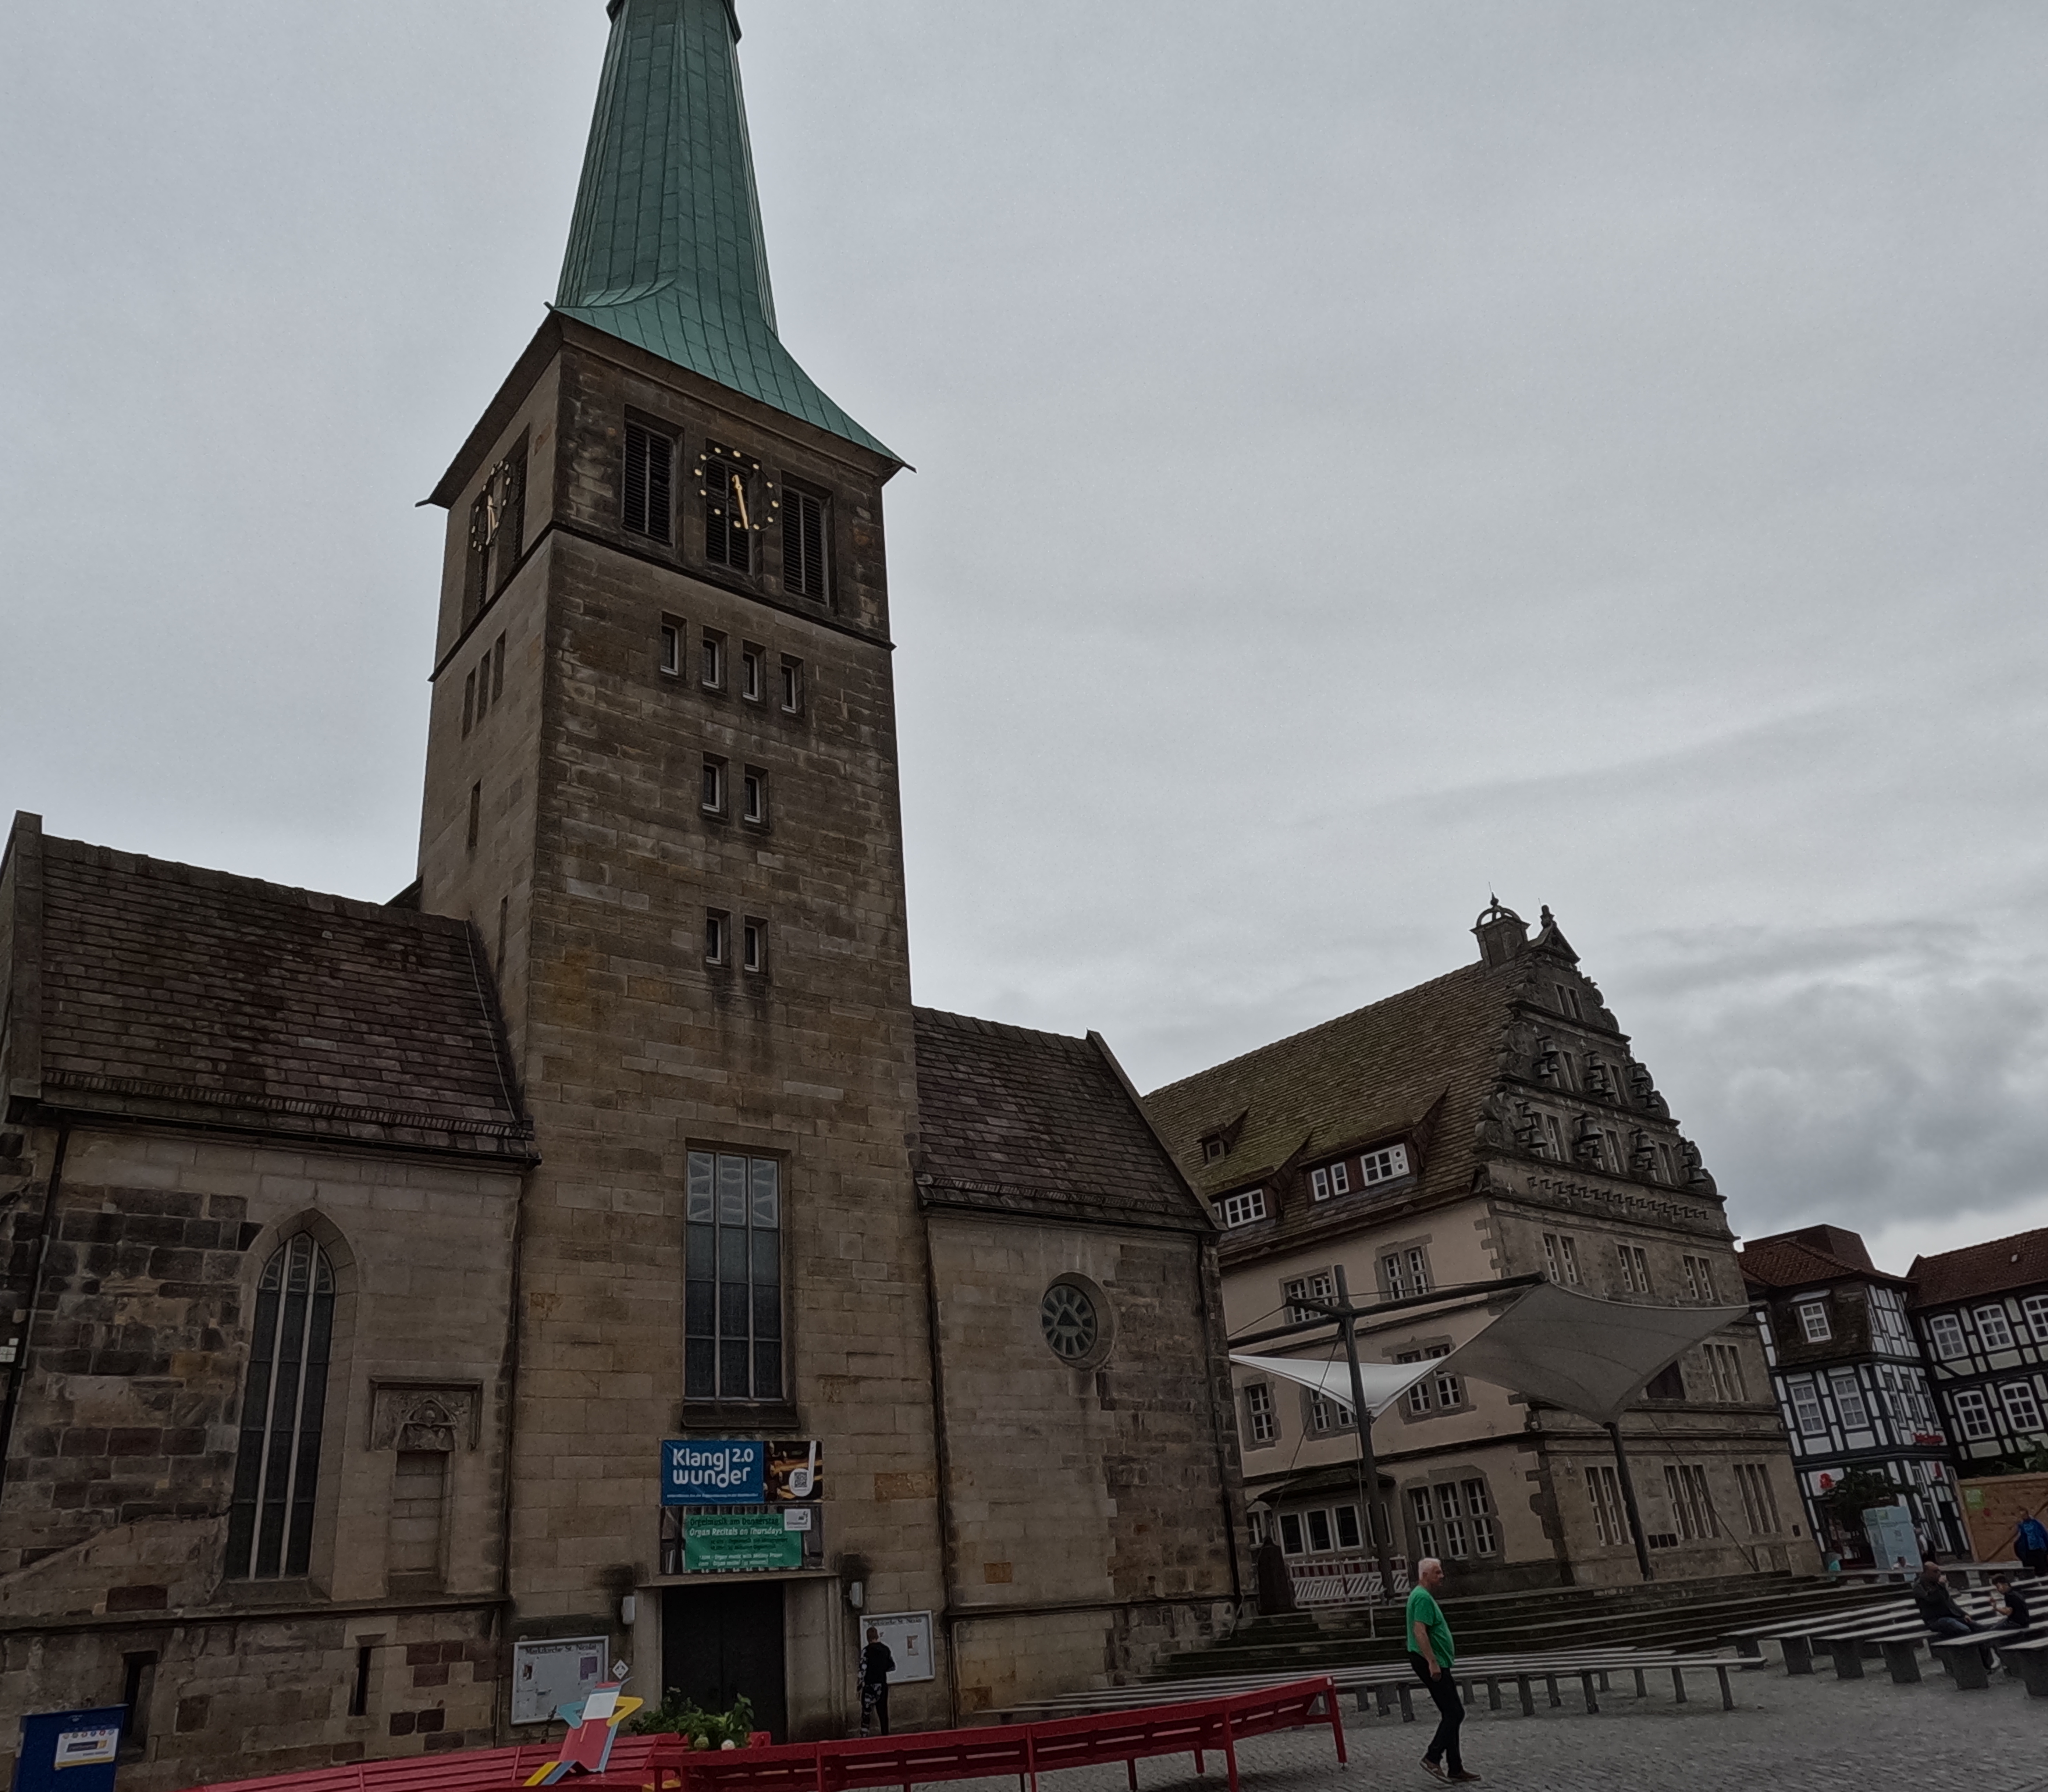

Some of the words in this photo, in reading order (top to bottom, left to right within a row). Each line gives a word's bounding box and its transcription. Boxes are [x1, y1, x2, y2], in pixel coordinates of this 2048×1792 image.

[673, 1448, 723, 1471] Klang
[732, 1448, 754, 1462] 2.0
[673, 1448, 751, 1488] wunder
[690, 1518, 728, 1526] Orgelmusik
[742, 1518, 779, 1526] Donnerstag
[689, 1528, 710, 1538] Organ
[712, 1527, 738, 1536] Recitals
[750, 1526, 783, 1536] Thursdays
